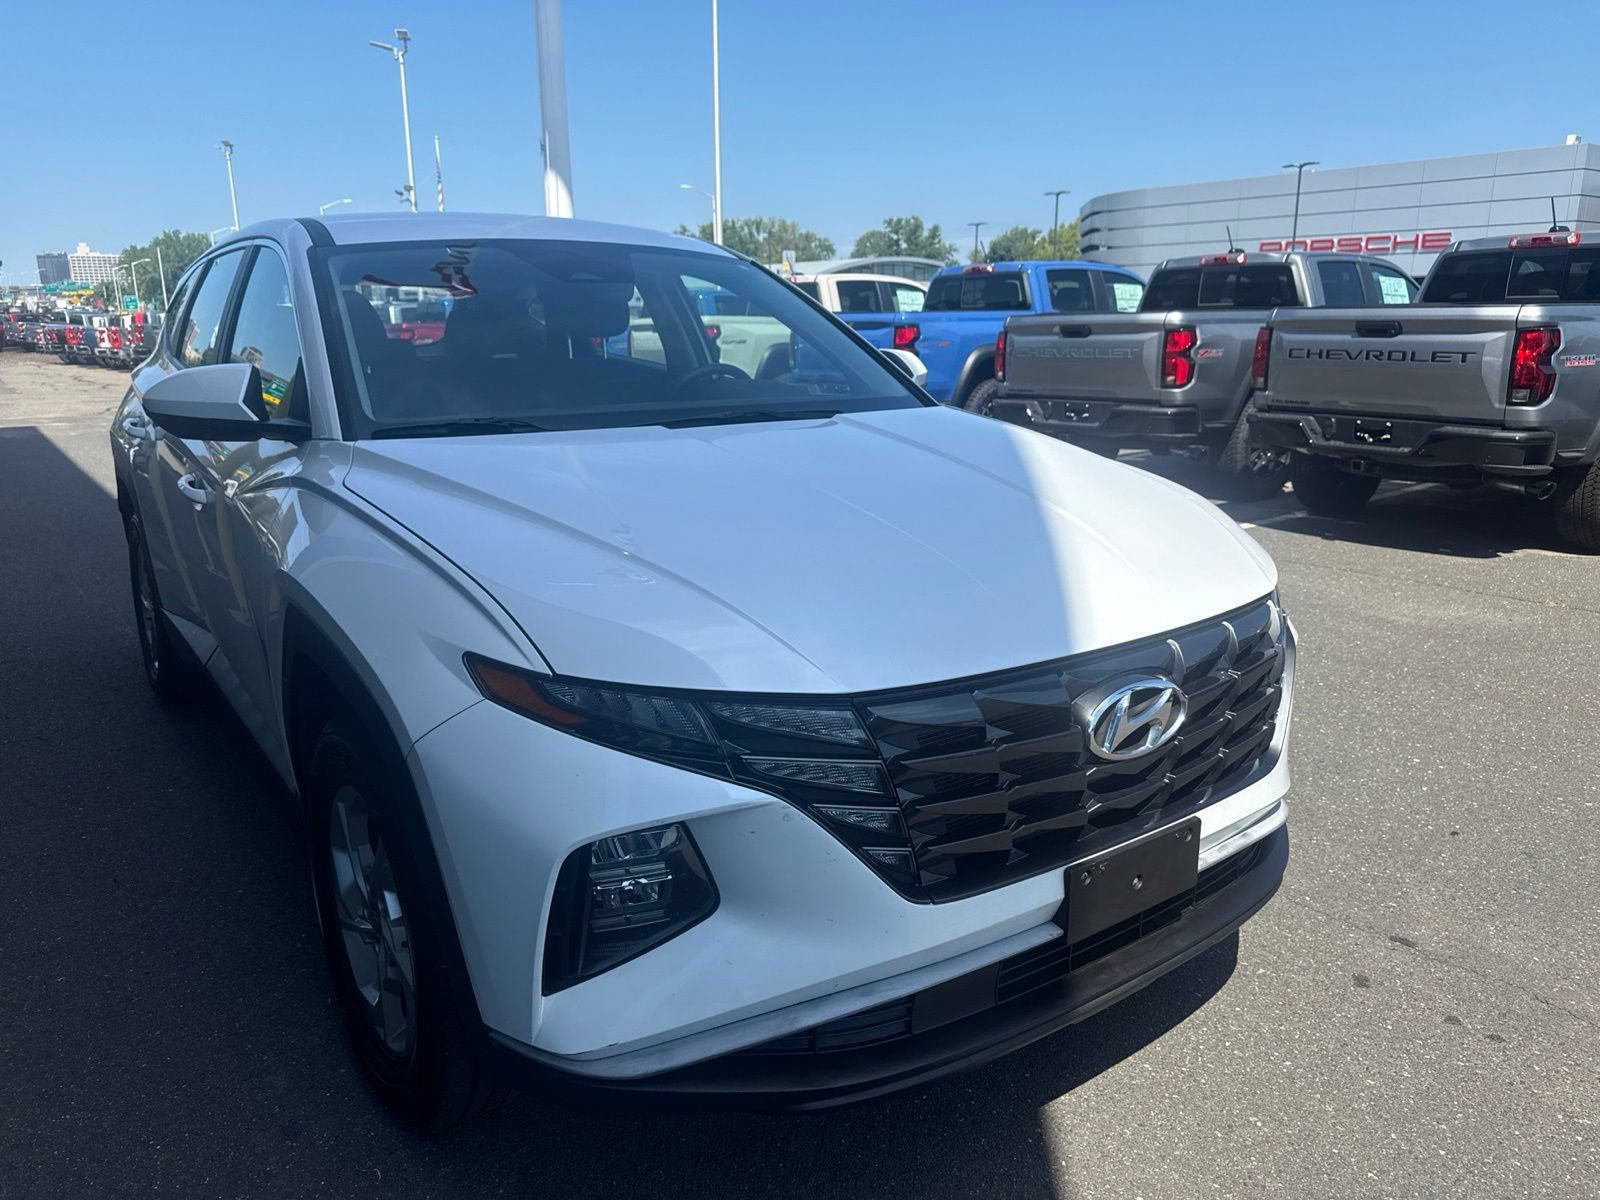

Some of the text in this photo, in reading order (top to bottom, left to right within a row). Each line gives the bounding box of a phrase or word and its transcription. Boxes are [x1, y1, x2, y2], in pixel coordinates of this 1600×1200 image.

[1259, 232, 1453, 253] PORSCHE
[1014, 347, 1140, 359] CHEVROLET
[1287, 347, 1477, 364] CHEVROLET
